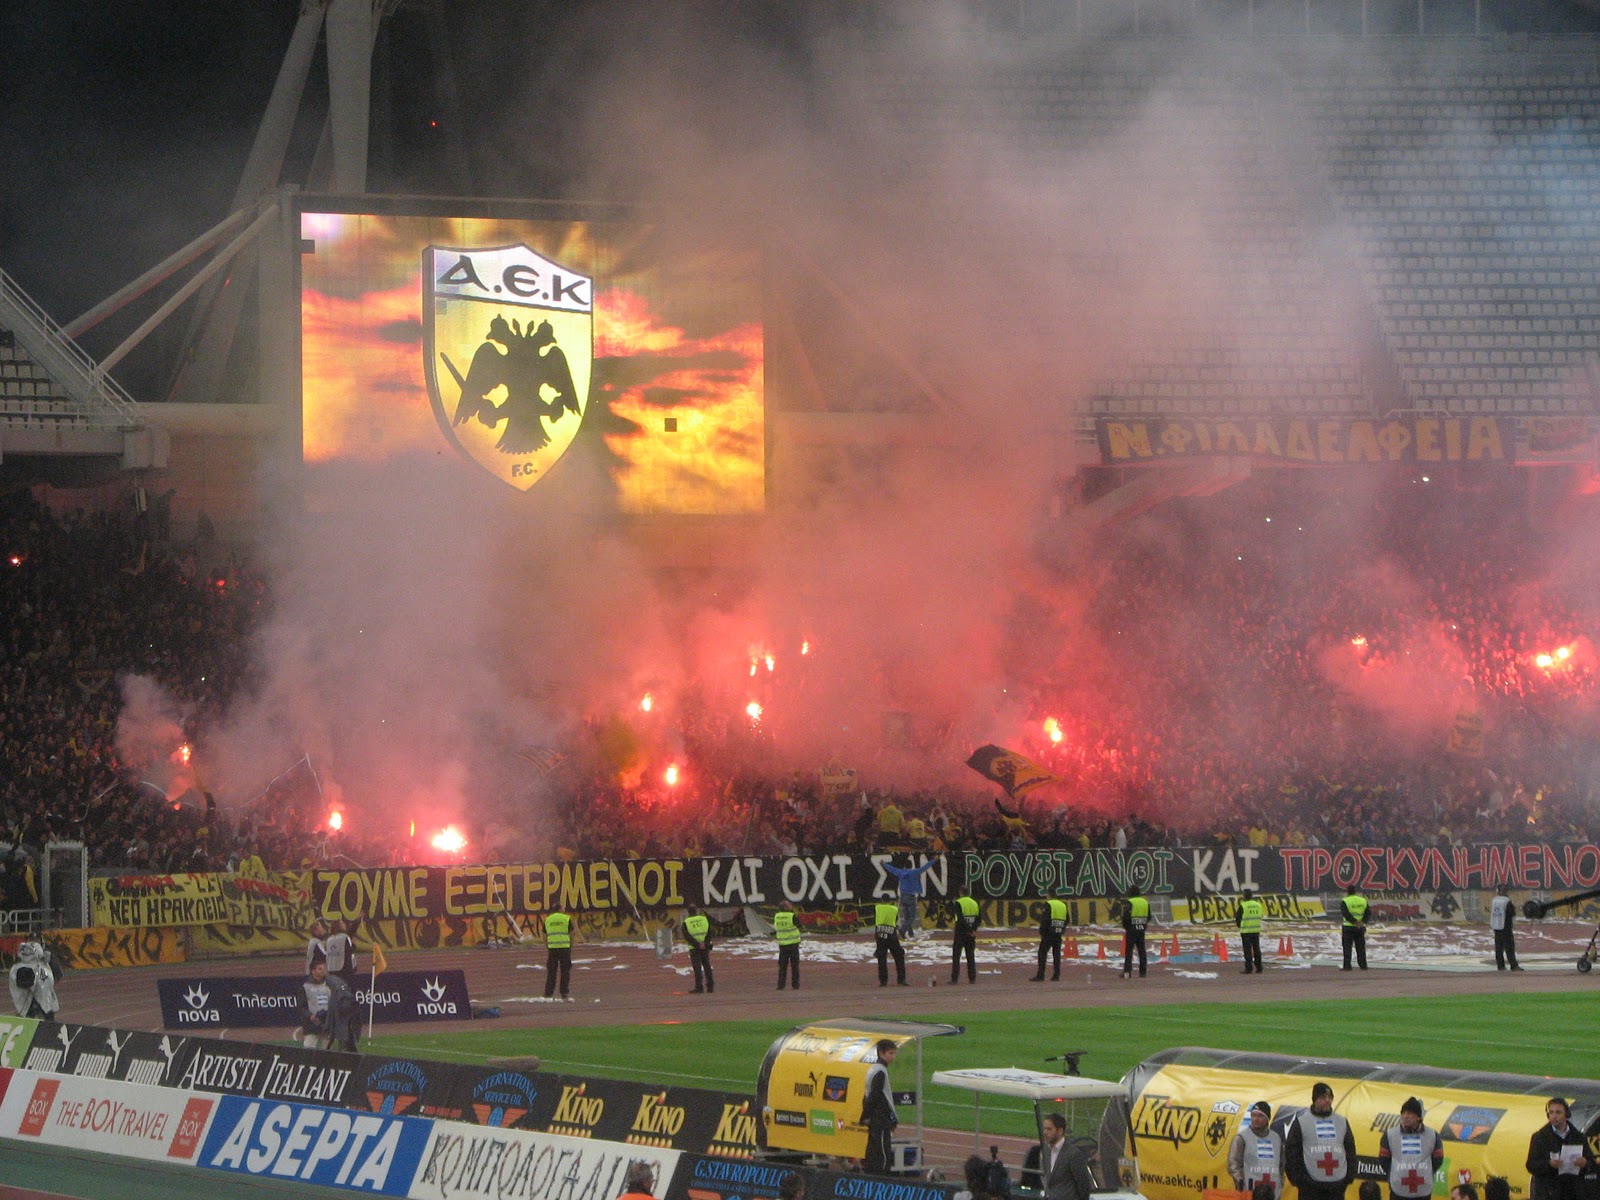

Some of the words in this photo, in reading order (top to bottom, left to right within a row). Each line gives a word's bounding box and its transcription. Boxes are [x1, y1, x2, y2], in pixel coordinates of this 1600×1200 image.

[317, 868, 429, 921] ΖΟΥΜΕ
[445, 860, 684, 916] ΕΞΕΓΕΡΜΕΝΟΙ
[701, 857, 765, 905] ΚΑΙ
[781, 855, 853, 902] ΟΧΙ
[870, 852, 948, 899] ΣΝ
[965, 850, 1174, 897] ΡΟΥΦΙΑΝΟΙ
[1193, 848, 1260, 892] ΚΑΙ
[1279, 844, 1600, 891] ΠΡΟΣΚΥΝΗΜΕΝΟ
[109, 898, 142, 926] ΝΕΟ
[1187, 893, 1303, 925] PERIERI
[232, 993, 298, 1009] Τηλεοπτι
[416, 1002, 458, 1015] nova
[178, 1009, 220, 1023] nova
[25, 1046, 63, 1072] PUMA
[73, 1052, 113, 1079] PUMA
[125, 1058, 166, 1086] PUMA
[177, 1046, 263, 1092] ARTISTI
[257, 1055, 352, 1103] ITALIANI
[29, 1100, 49, 1116] BOX
[56, 1101, 84, 1128] THE
[79, 1098, 124, 1134] BOX
[117, 1108, 170, 1141] TRAVEL
[553, 1083, 604, 1128] KINO
[632, 1092, 686, 1137] KINO
[1136, 1097, 1200, 1142] KINO
[179, 1120, 200, 1137] BOX
[715, 1101, 756, 1146] KIN
[210, 1102, 404, 1191] ASEPTA
[694, 1158, 795, 1188] G.STAVROPOULO
[1357, 1160, 1386, 1176] ITALIAN
[1140, 1173, 1204, 1192] www.aekfc.g
